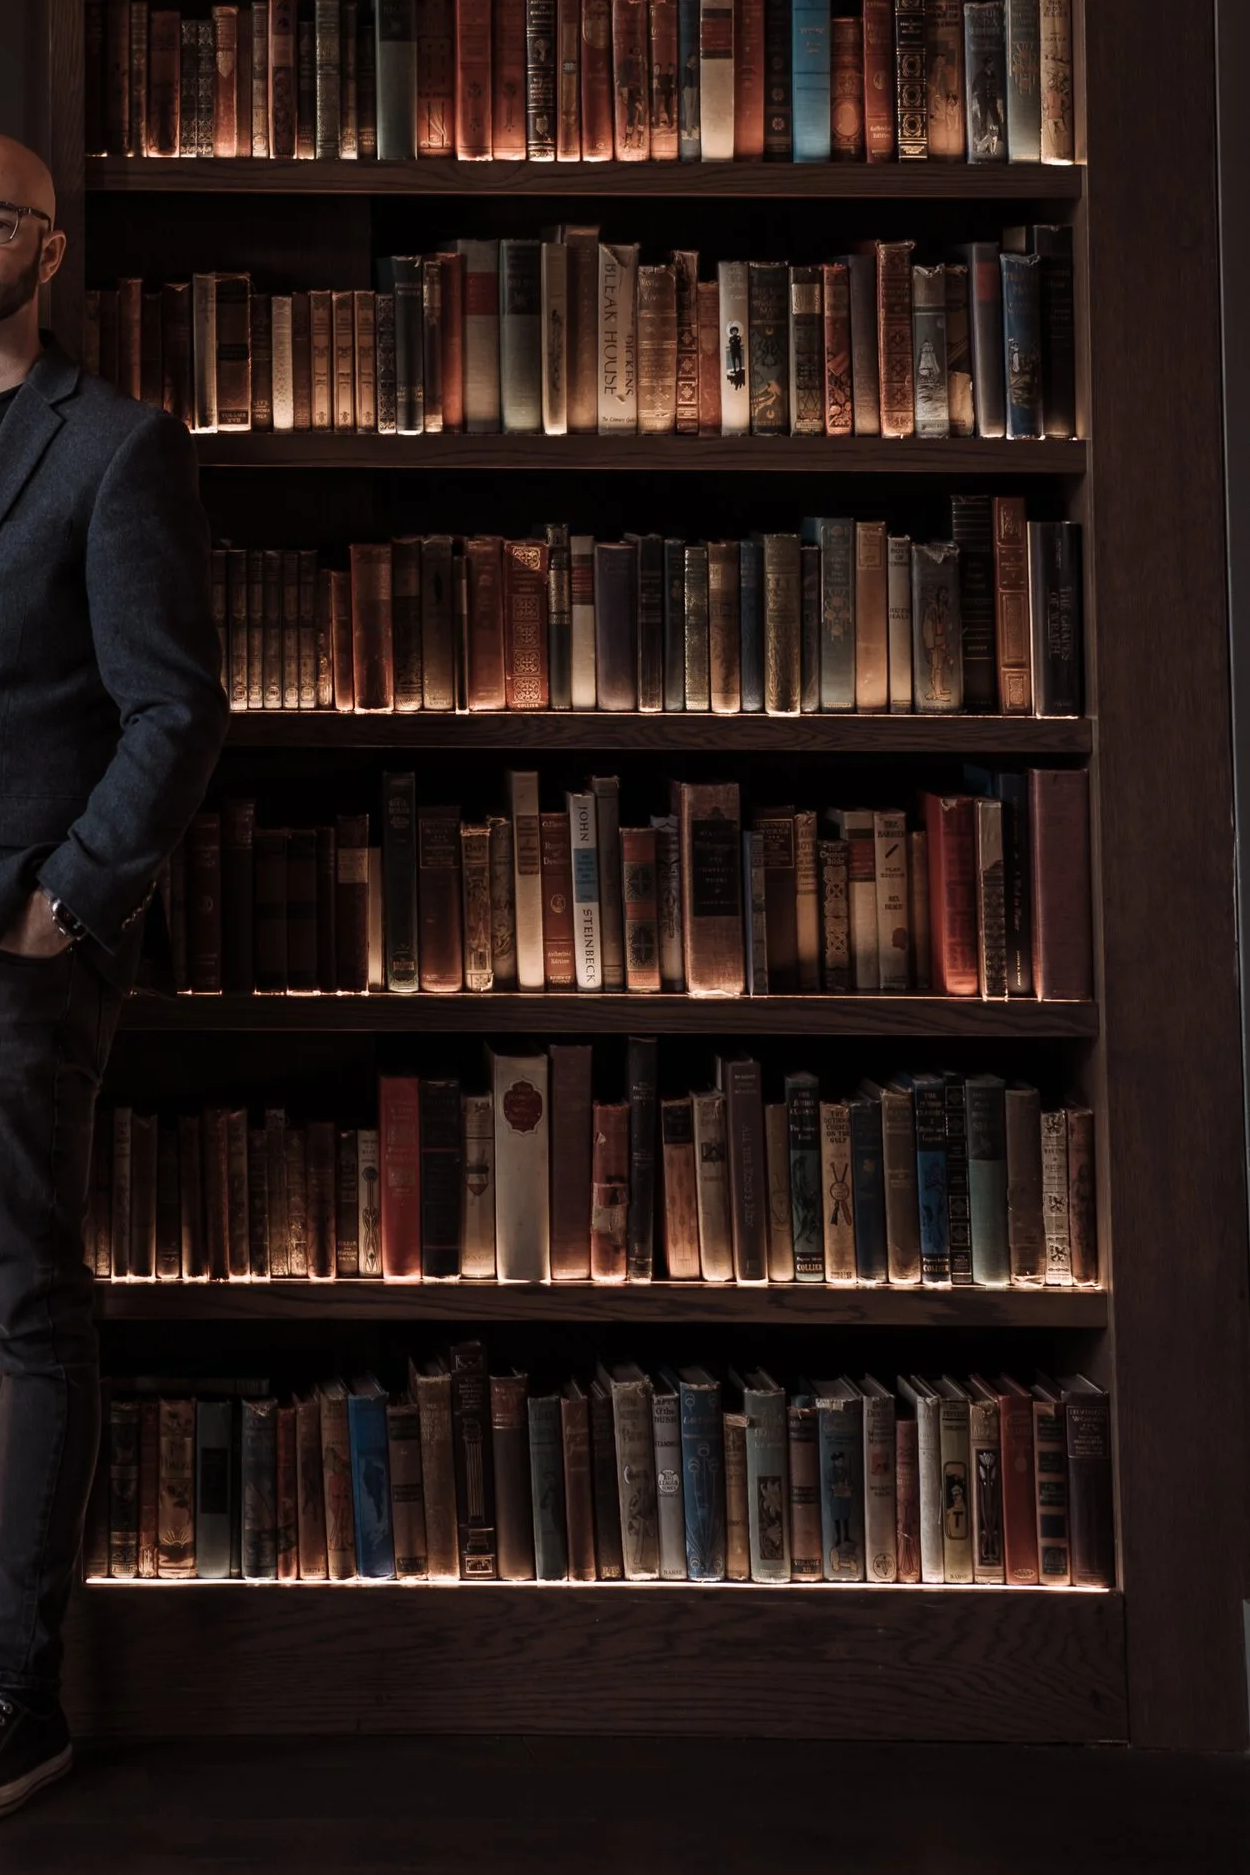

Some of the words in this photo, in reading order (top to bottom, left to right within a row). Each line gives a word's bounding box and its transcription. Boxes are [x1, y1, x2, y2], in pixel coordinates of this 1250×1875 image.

[603, 263, 617, 322] BLEAK
[603, 330, 618, 395] HOUSE
[624, 335, 634, 396] DICKENS
[1049, 612, 1061, 655] WRATH
[1060, 615, 1072, 662] GRAPES
[577, 805, 590, 842] JOHN
[582, 909, 596, 983] STEINBECK
